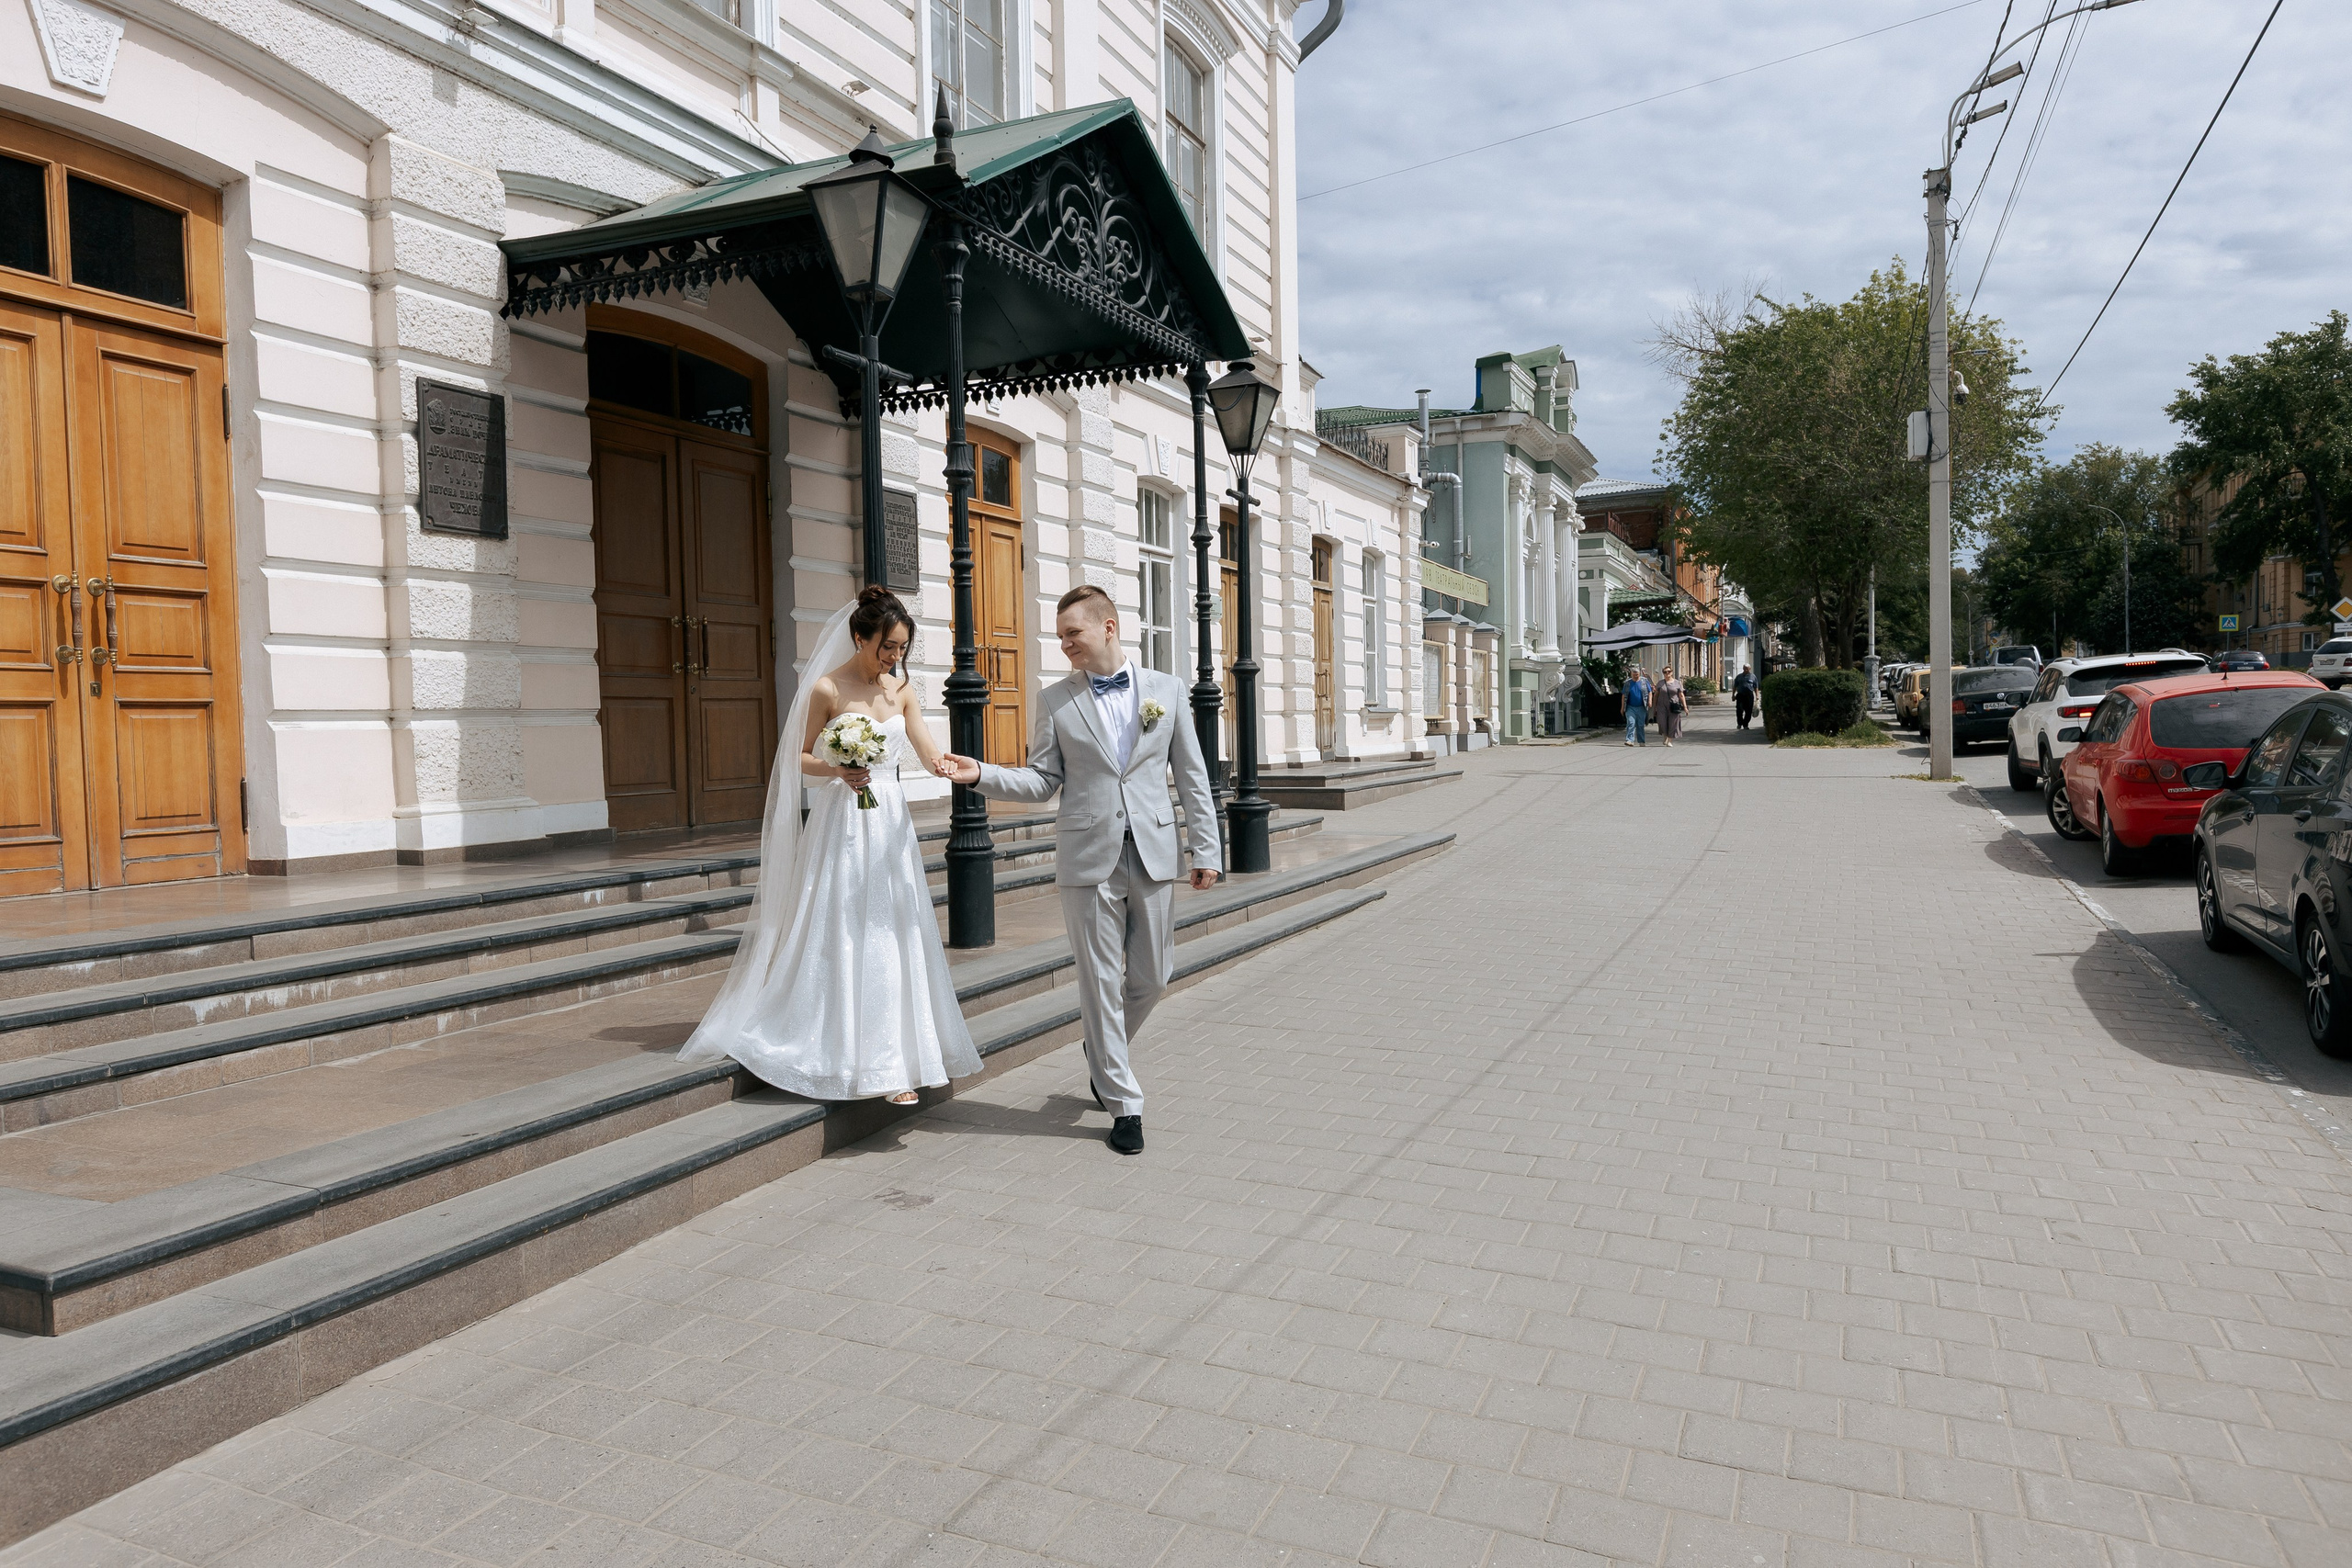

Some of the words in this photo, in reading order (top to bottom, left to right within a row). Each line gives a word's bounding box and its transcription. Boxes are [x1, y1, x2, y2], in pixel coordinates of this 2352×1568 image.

[449, 501, 484, 517] ЧЕХОВА
[1435, 570, 1465, 592] ТЕАТРАЛЬНЫЙ
[1467, 581, 1480, 597] СЕЗОН
